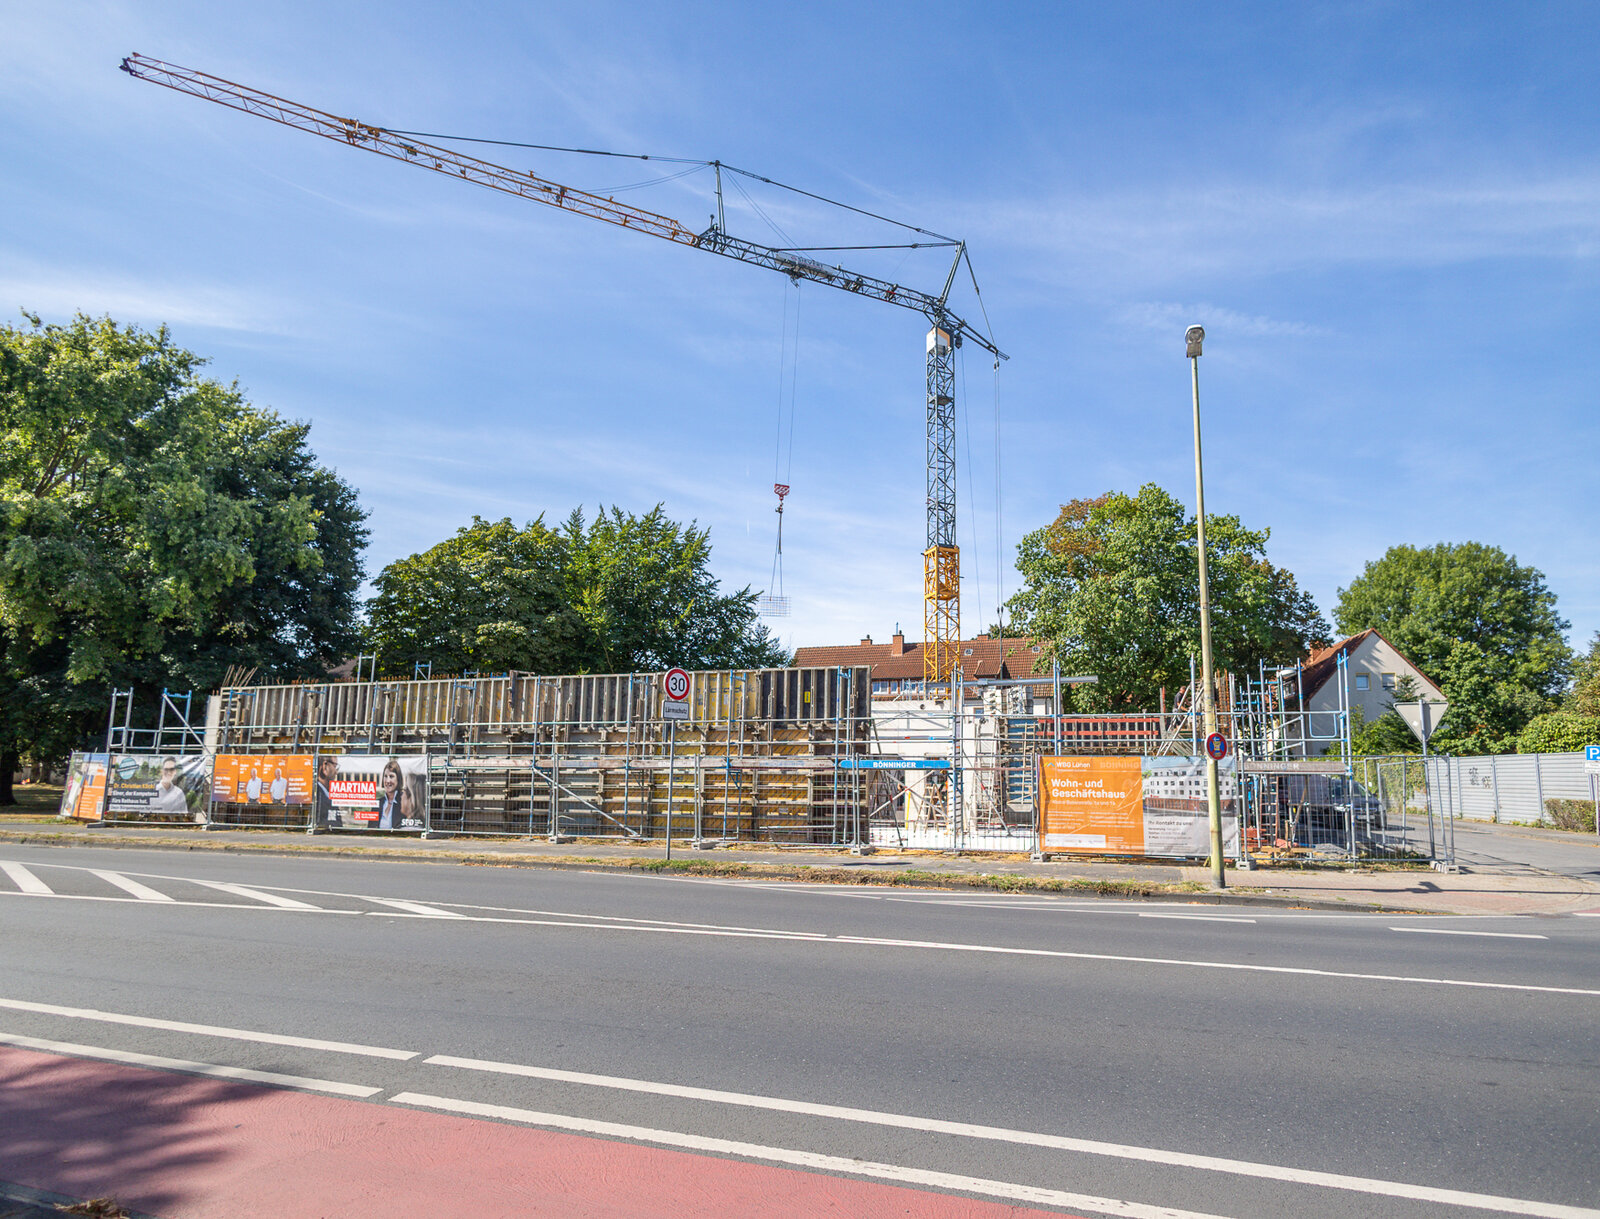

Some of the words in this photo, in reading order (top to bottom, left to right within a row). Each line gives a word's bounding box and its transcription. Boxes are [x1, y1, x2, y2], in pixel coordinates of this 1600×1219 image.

[670, 677, 685, 691] 30
[1590, 747, 1599, 759] P
[331, 782, 375, 793] MARTINA
[1051, 778, 1082, 787] Wohn-
[1085, 779, 1103, 788] und
[1052, 788, 1125, 798] Geschäftshaus
[401, 818, 414, 826] SPD
